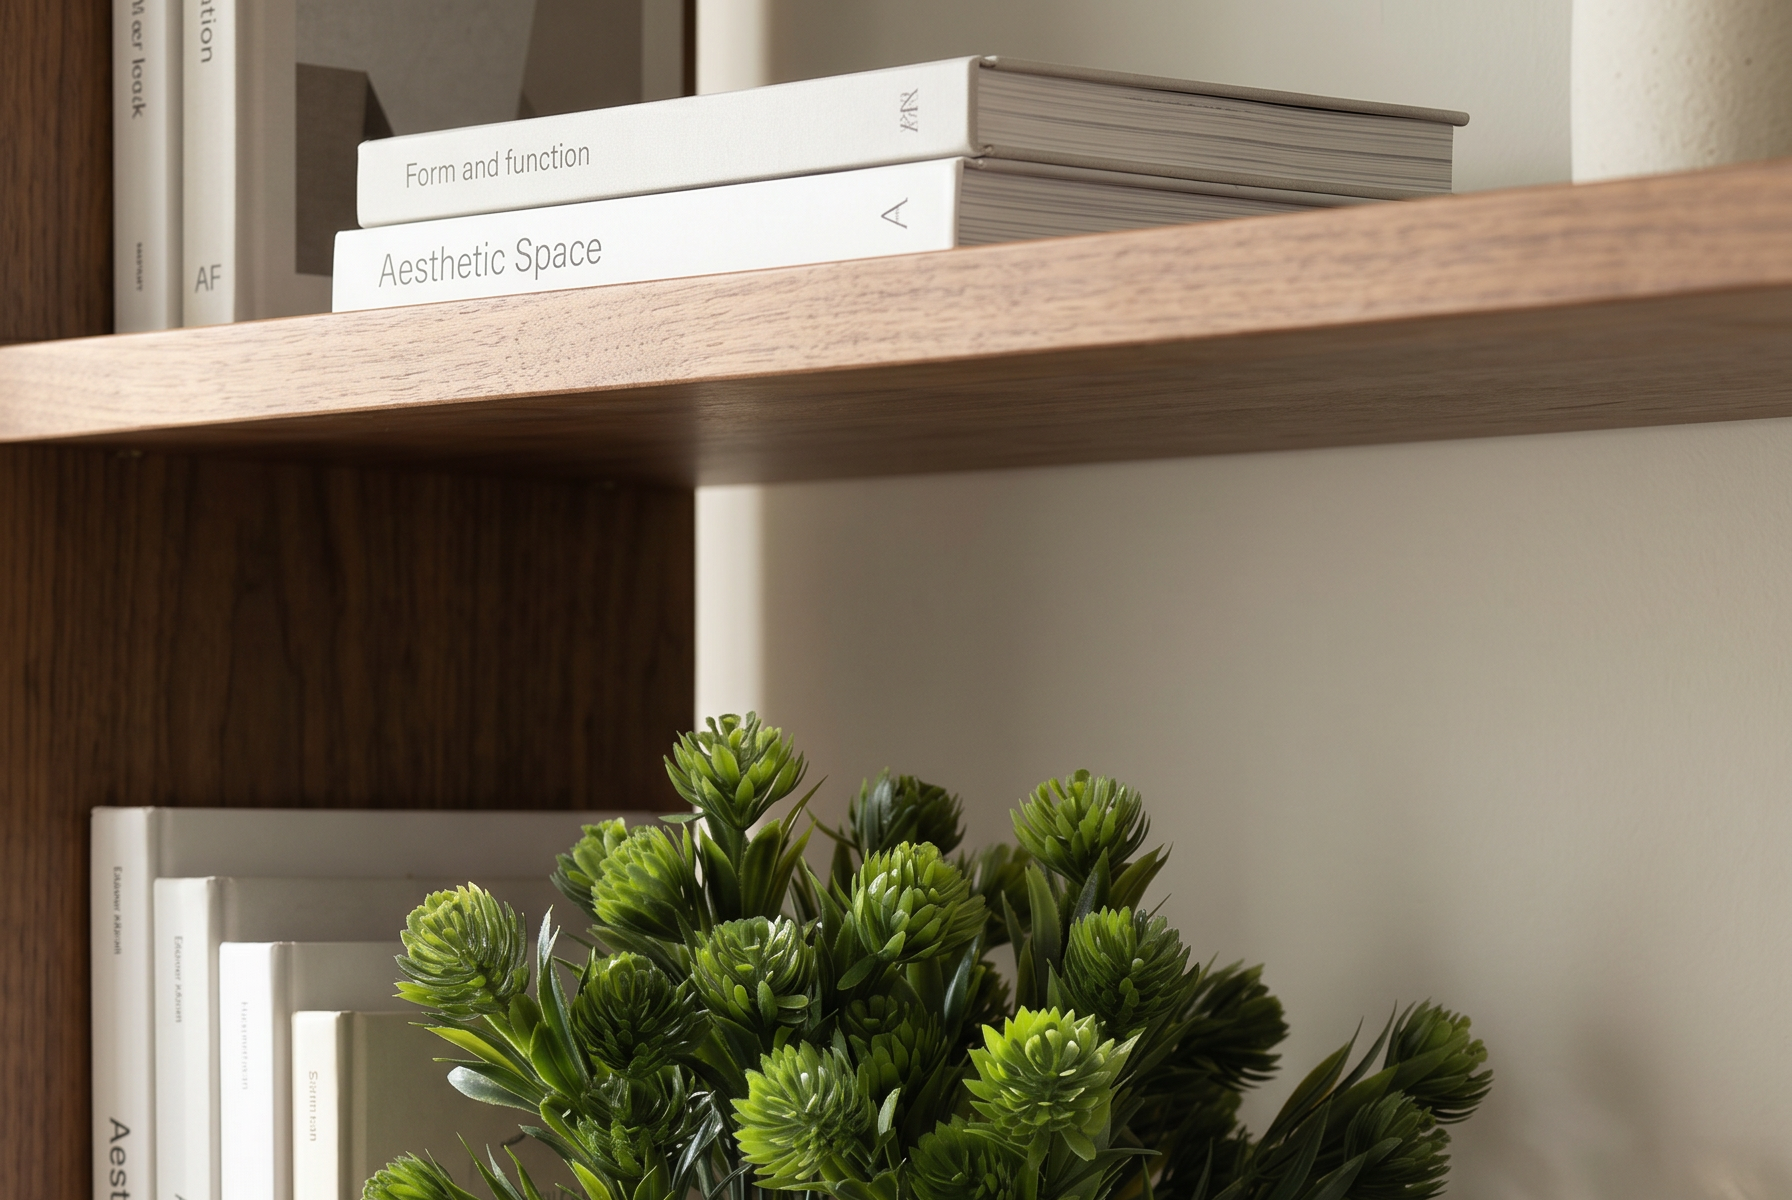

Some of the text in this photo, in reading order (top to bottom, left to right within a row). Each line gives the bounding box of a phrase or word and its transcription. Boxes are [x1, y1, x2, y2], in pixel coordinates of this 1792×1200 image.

[407, 143, 590, 188] Form and function
[195, 264, 222, 293] AF
[379, 237, 602, 288] Aesthetic Space
